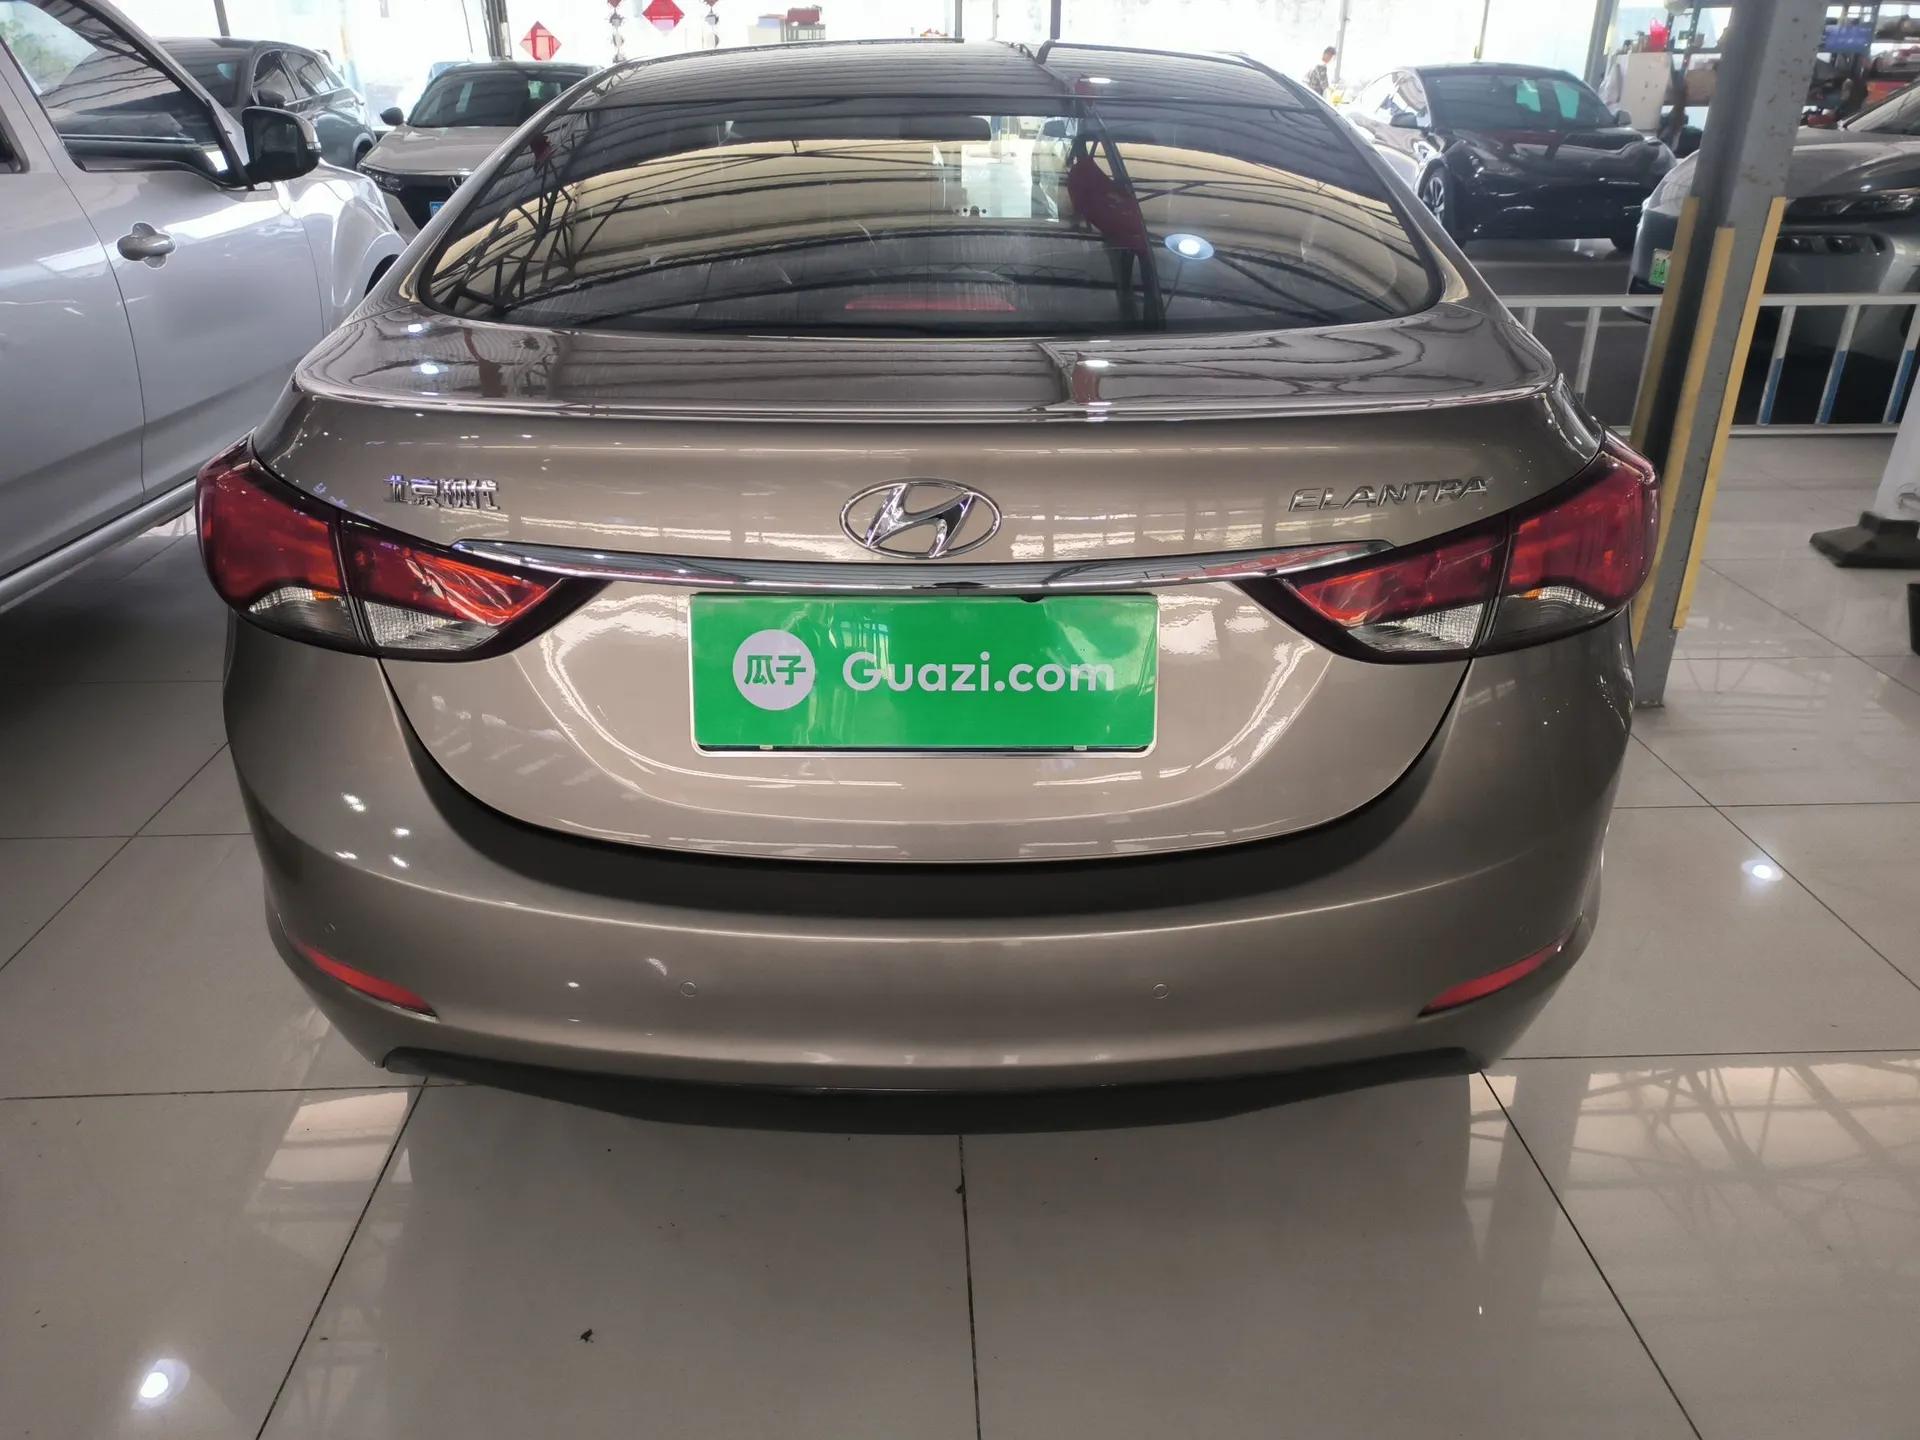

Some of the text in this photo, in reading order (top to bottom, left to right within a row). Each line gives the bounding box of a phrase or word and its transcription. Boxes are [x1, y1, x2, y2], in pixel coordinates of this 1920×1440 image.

[1288, 476, 1488, 512] ELANTRA
[744, 654, 807, 686] 瓜子
[842, 650, 1115, 692] Guazi.com
